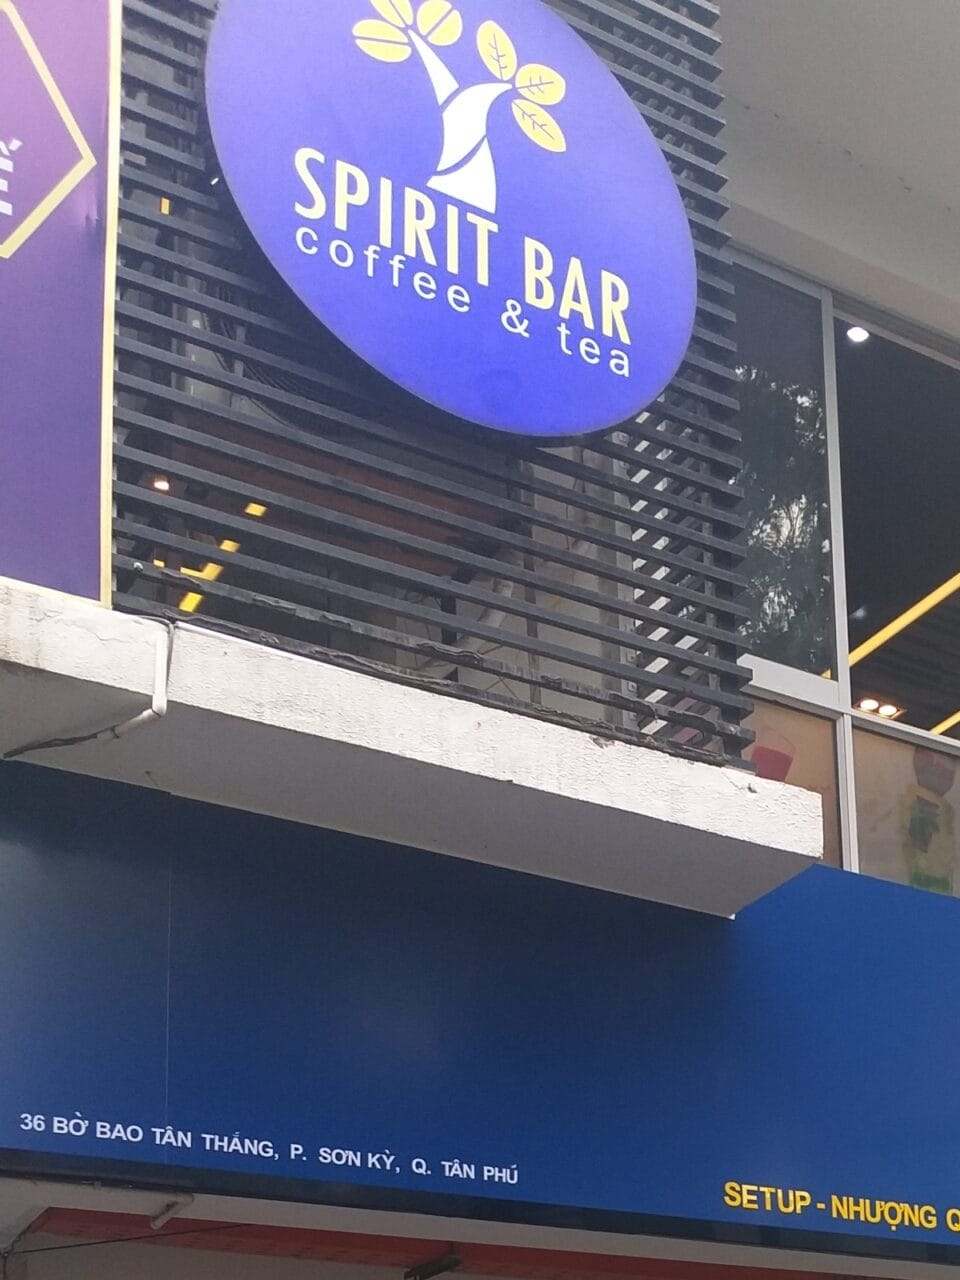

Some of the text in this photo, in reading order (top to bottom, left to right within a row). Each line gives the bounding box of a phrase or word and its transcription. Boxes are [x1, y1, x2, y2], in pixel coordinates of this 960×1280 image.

[294, 147, 631, 345] SPIRIT BAR
[295, 226, 630, 377] coffee & tea
[20, 1113, 46, 1132] 36
[52, 1111, 88, 1136] BỜ
[95, 1120, 144, 1142] BAO
[151, 1126, 192, 1148] TÂN
[290, 1143, 307, 1161] P.
[318, 1147, 361, 1168] SƠN
[411, 1158, 431, 1175] Q.
[441, 1159, 476, 1180] TÂN
[483, 1165, 519, 1185] PHÚ
[724, 1181, 811, 1214] SETUP
[831, 1194, 937, 1231] NHƯỢNG
